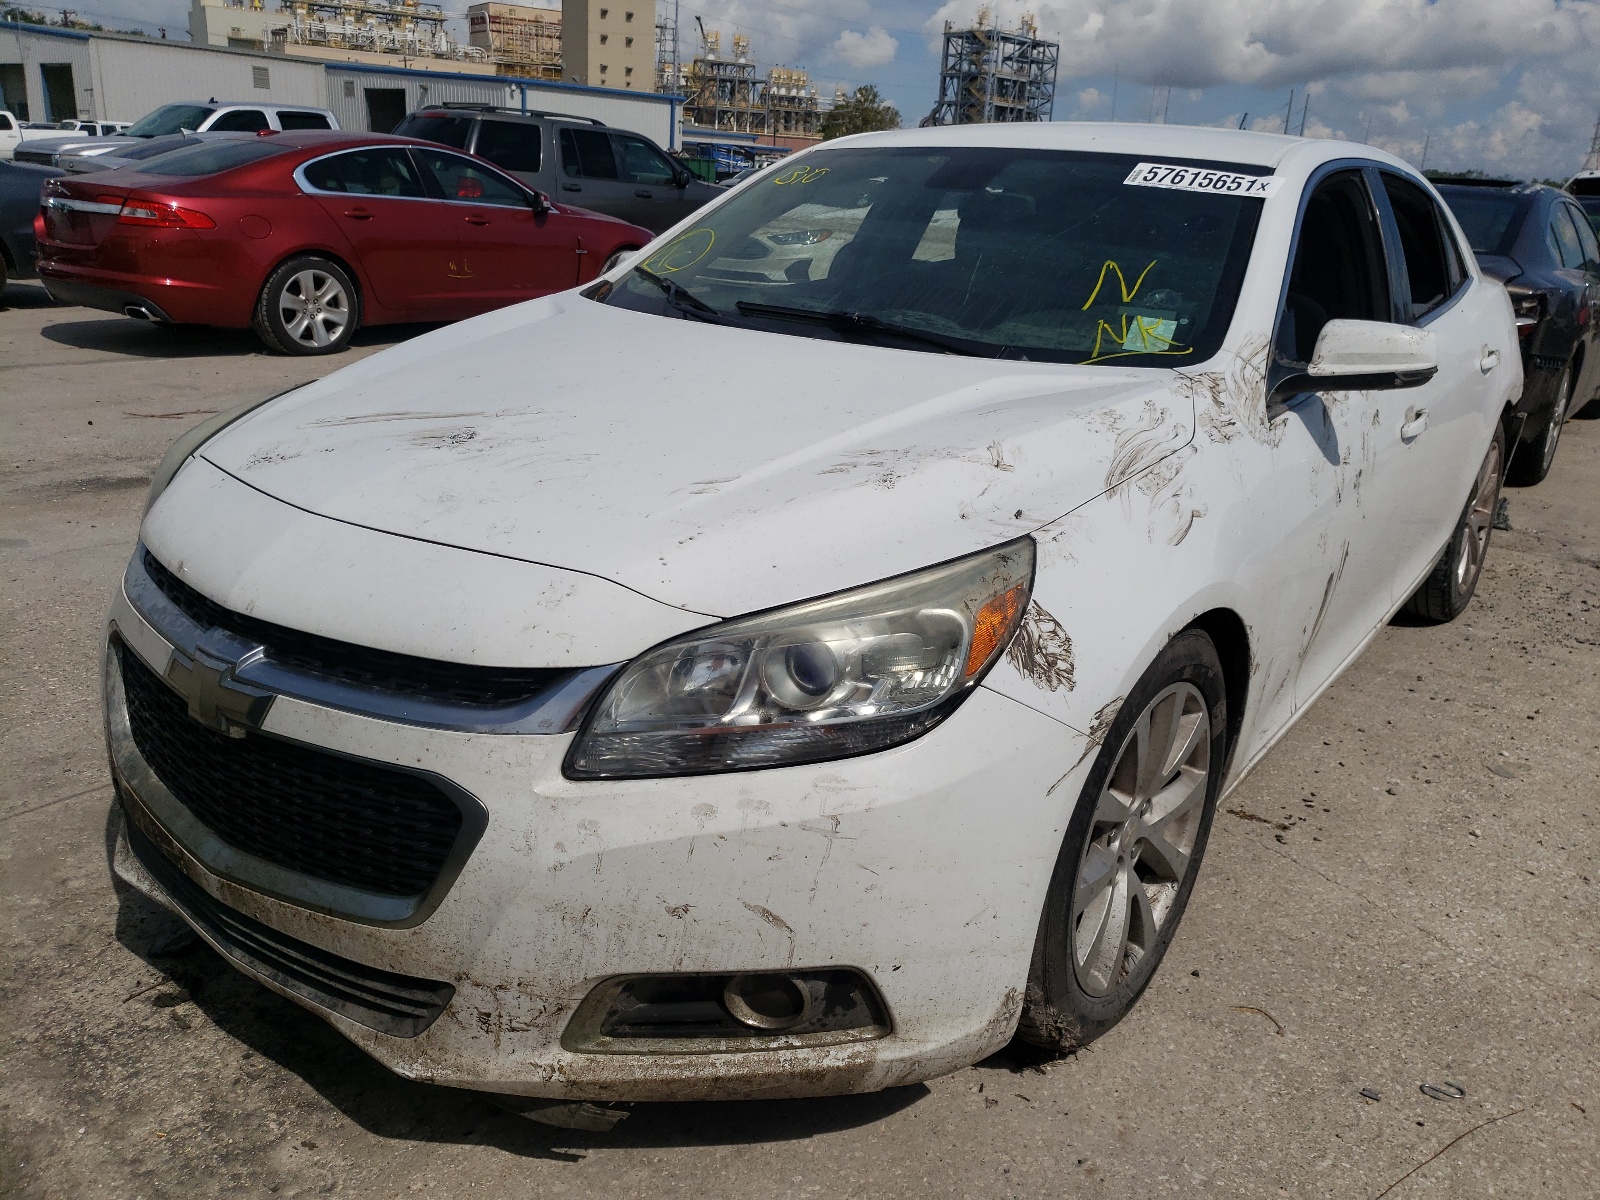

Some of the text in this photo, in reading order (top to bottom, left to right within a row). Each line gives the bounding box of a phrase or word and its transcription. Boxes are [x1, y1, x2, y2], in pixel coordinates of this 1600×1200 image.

[1142, 166, 1258, 192] 57615651
[1081, 260, 1157, 311] N
[1091, 313, 1185, 358] NK
